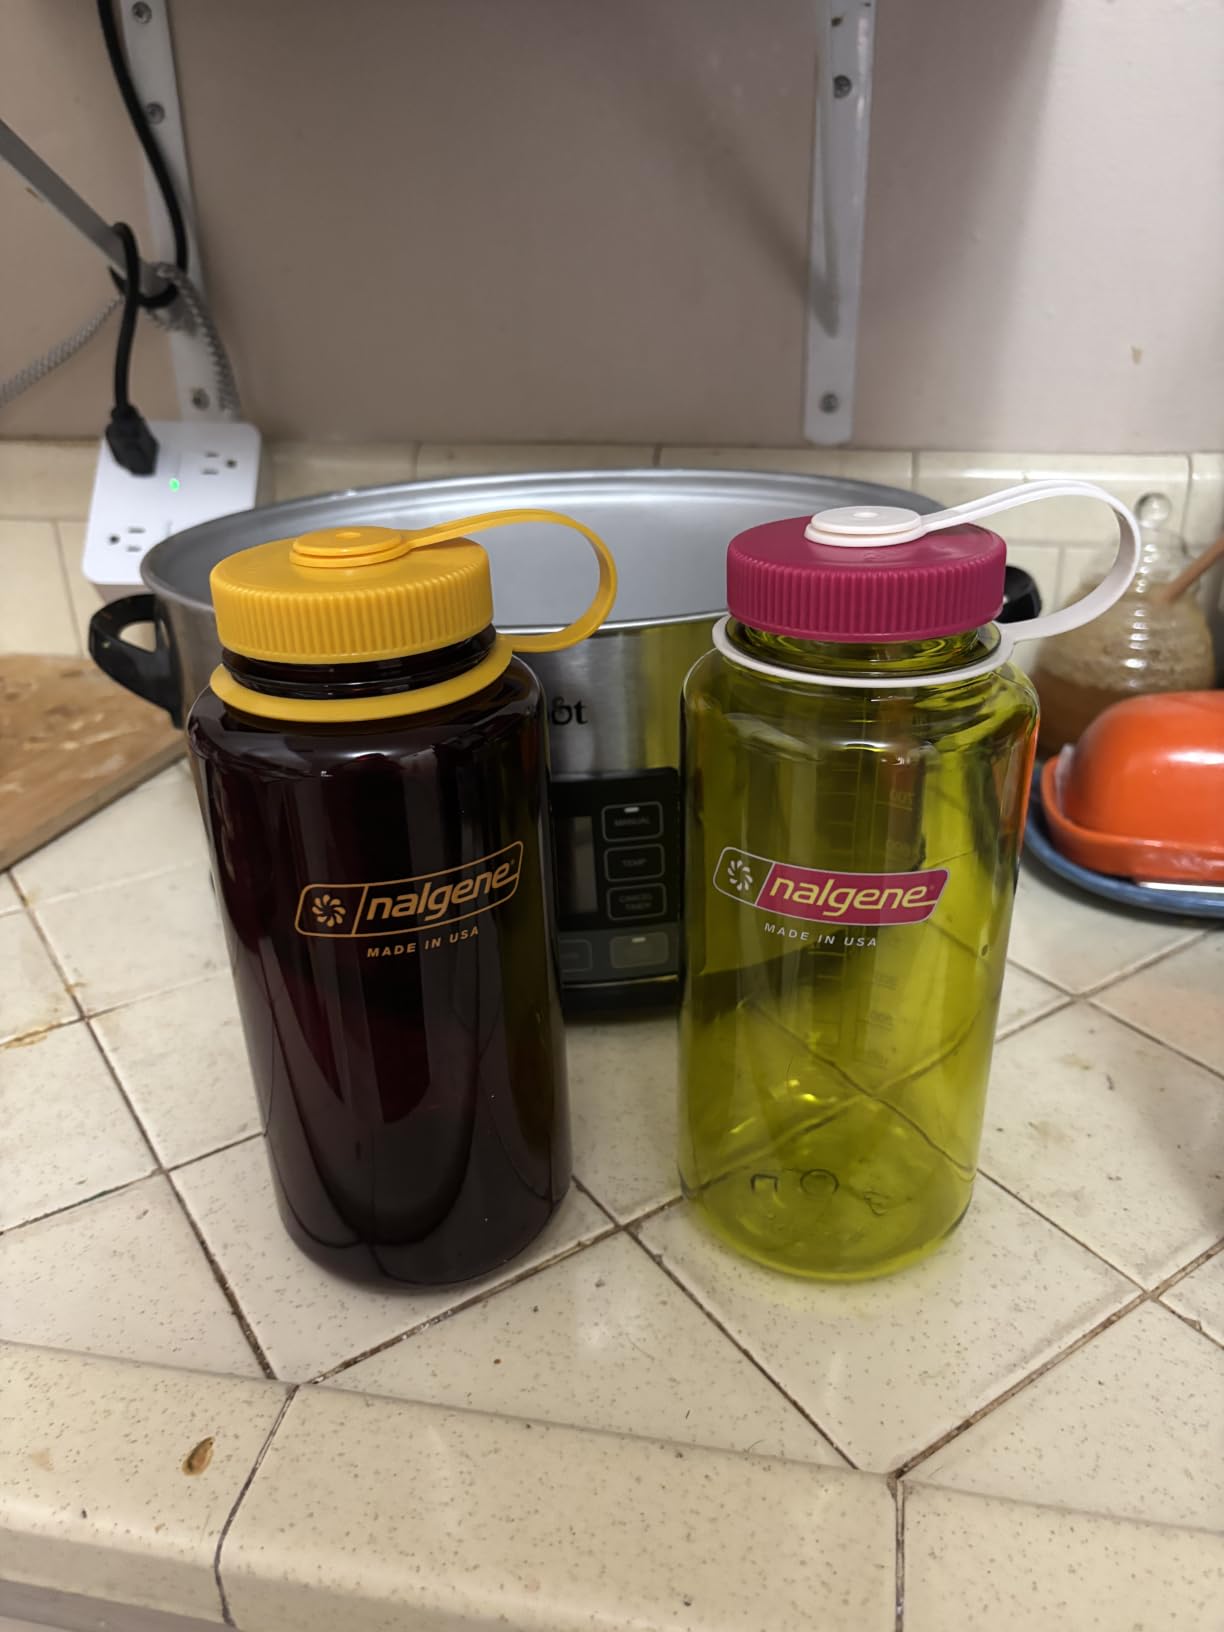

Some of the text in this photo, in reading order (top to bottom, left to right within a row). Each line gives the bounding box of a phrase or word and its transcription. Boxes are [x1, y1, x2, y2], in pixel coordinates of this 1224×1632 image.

[366, 860, 513, 922] nalgene
[769, 877, 932, 917] nalgene
[366, 925, 480, 959] MADE IN USA
[764, 922, 877, 948] MADE IN USA
